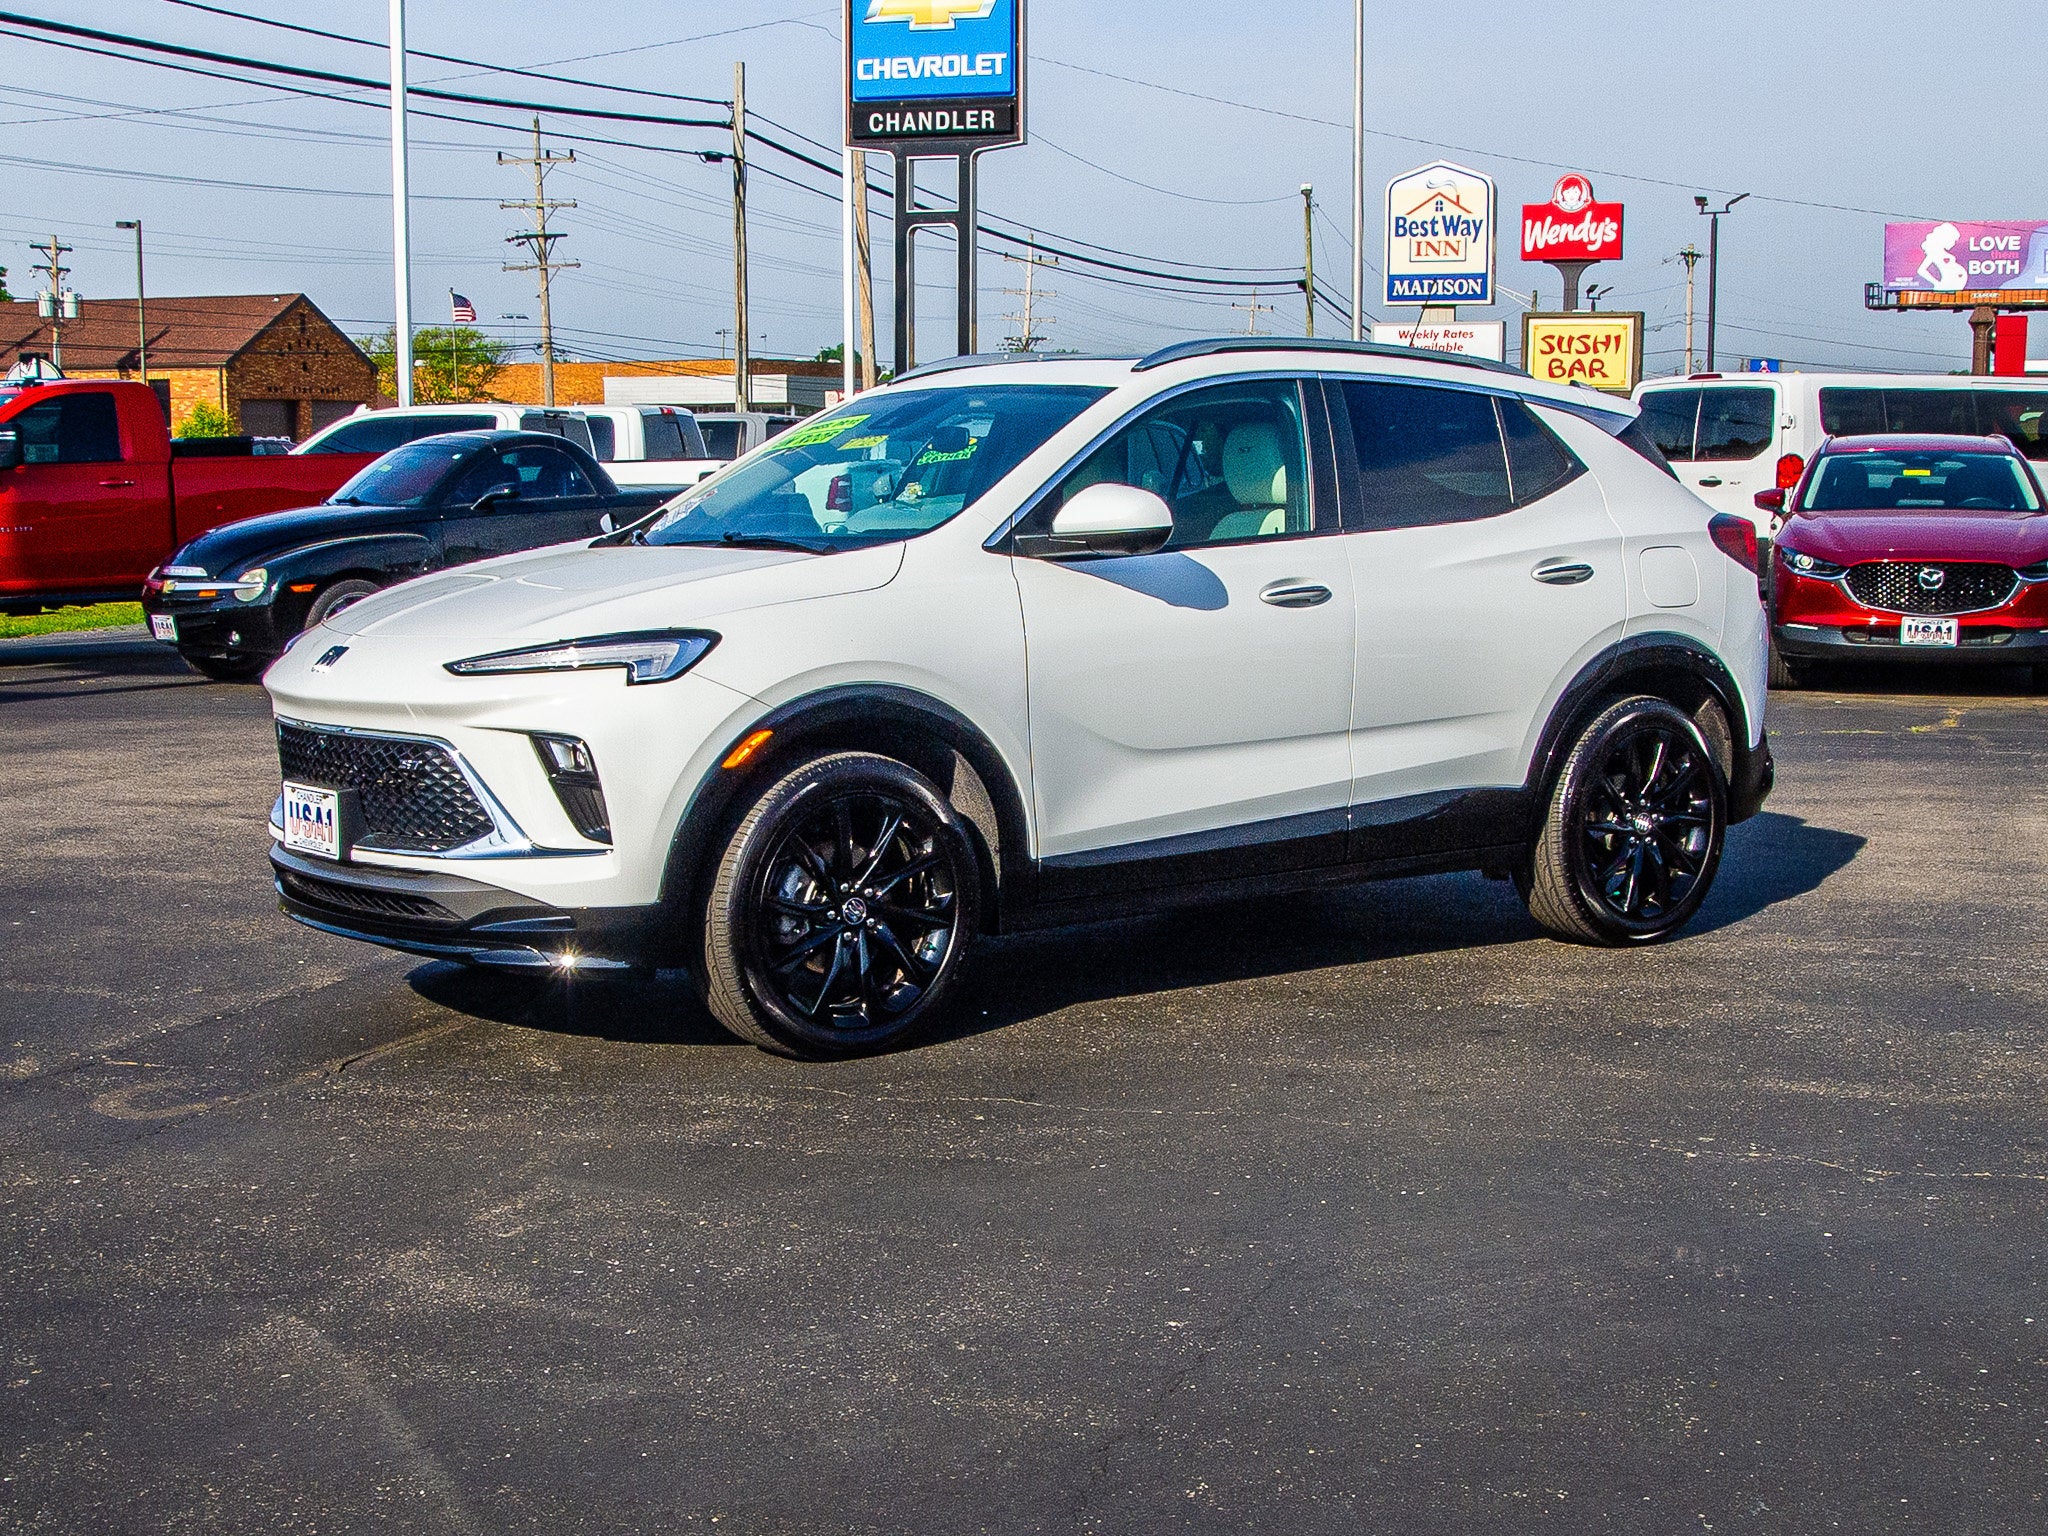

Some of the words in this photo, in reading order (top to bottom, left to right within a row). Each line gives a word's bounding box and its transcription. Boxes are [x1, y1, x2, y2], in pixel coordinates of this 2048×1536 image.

[857, 52, 1007, 81] CHEVROLET
[869, 109, 995, 133] CHANDLER
[1394, 215, 1439, 237] Best
[1441, 214, 1484, 243] Way
[1524, 210, 1618, 252] Wendy's
[1414, 240, 1462, 256] INN
[1969, 235, 2021, 251] LOVE
[1968, 259, 2020, 275] BOTH
[1392, 279, 1482, 296] MADISON
[1398, 329, 1439, 341] Weekly
[1443, 329, 1475, 339] Rates
[1539, 334, 1621, 355] SUSHI
[1548, 358, 1610, 379] BAR
